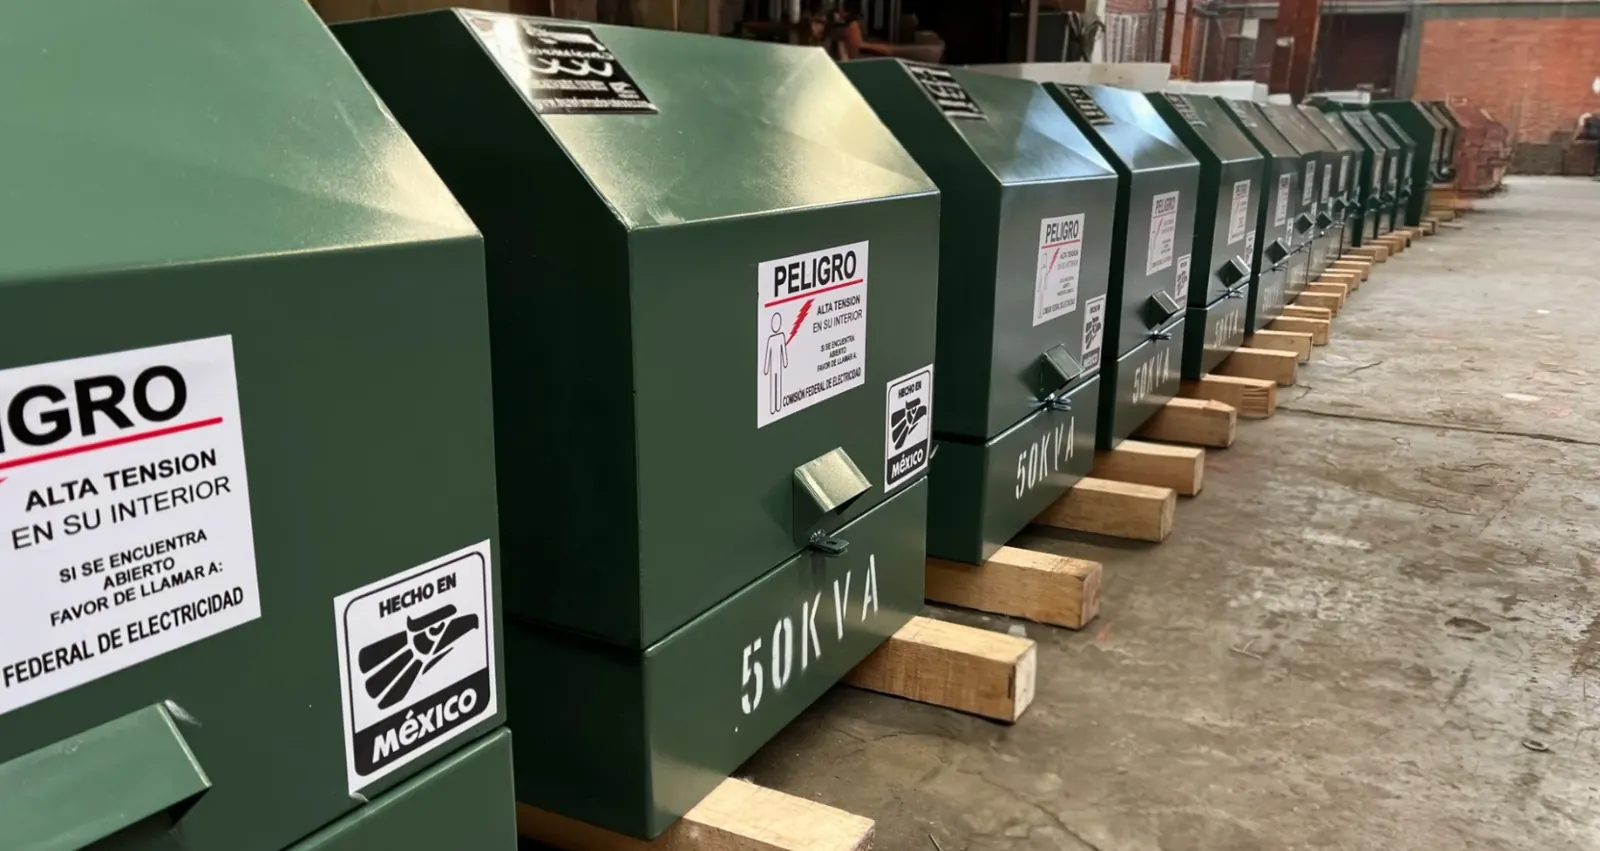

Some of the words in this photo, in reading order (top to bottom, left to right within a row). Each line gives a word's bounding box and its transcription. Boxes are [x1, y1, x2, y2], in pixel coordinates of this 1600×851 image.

[1045, 219, 1080, 243] PELIGRO
[774, 250, 857, 297] PELIGRO
[812, 321, 822, 333] EN
[823, 317, 833, 330] SU
[833, 309, 863, 327] INTERIOR
[817, 302, 833, 316] ALTA
[833, 294, 861, 310] TENSION
[805, 381, 826, 398] FEDERAL
[826, 377, 832, 389] DE
[832, 366, 862, 387] ELECTRICIDAD
[898, 383, 915, 399] HECHO
[914, 380, 922, 391] EN
[1132, 347, 1169, 404] 50KVA
[25, 477, 99, 512] ALTA
[103, 448, 217, 491] TENSION
[1015, 416, 1075, 500] 50KVA
[11, 521, 53, 550] EN
[63, 508, 101, 536] SU
[110, 475, 232, 523] INTERIOR
[59, 566, 77, 583] SI
[81, 558, 105, 577] SE
[109, 528, 208, 569] ENCUENTRA
[103, 556, 176, 591] ABIERTO
[50, 597, 110, 627] FAVOR
[113, 587, 136, 606] DE
[140, 565, 206, 598] LLAMAR
[208, 561, 223, 576] A:
[378, 582, 436, 618] HECHO
[437, 572, 457, 594] EN
[2, 640, 95, 688] FEDERAL
[97, 628, 123, 653] DE
[126, 586, 244, 644] ELECTRICIDAD
[741, 553, 878, 714] 50KVA
